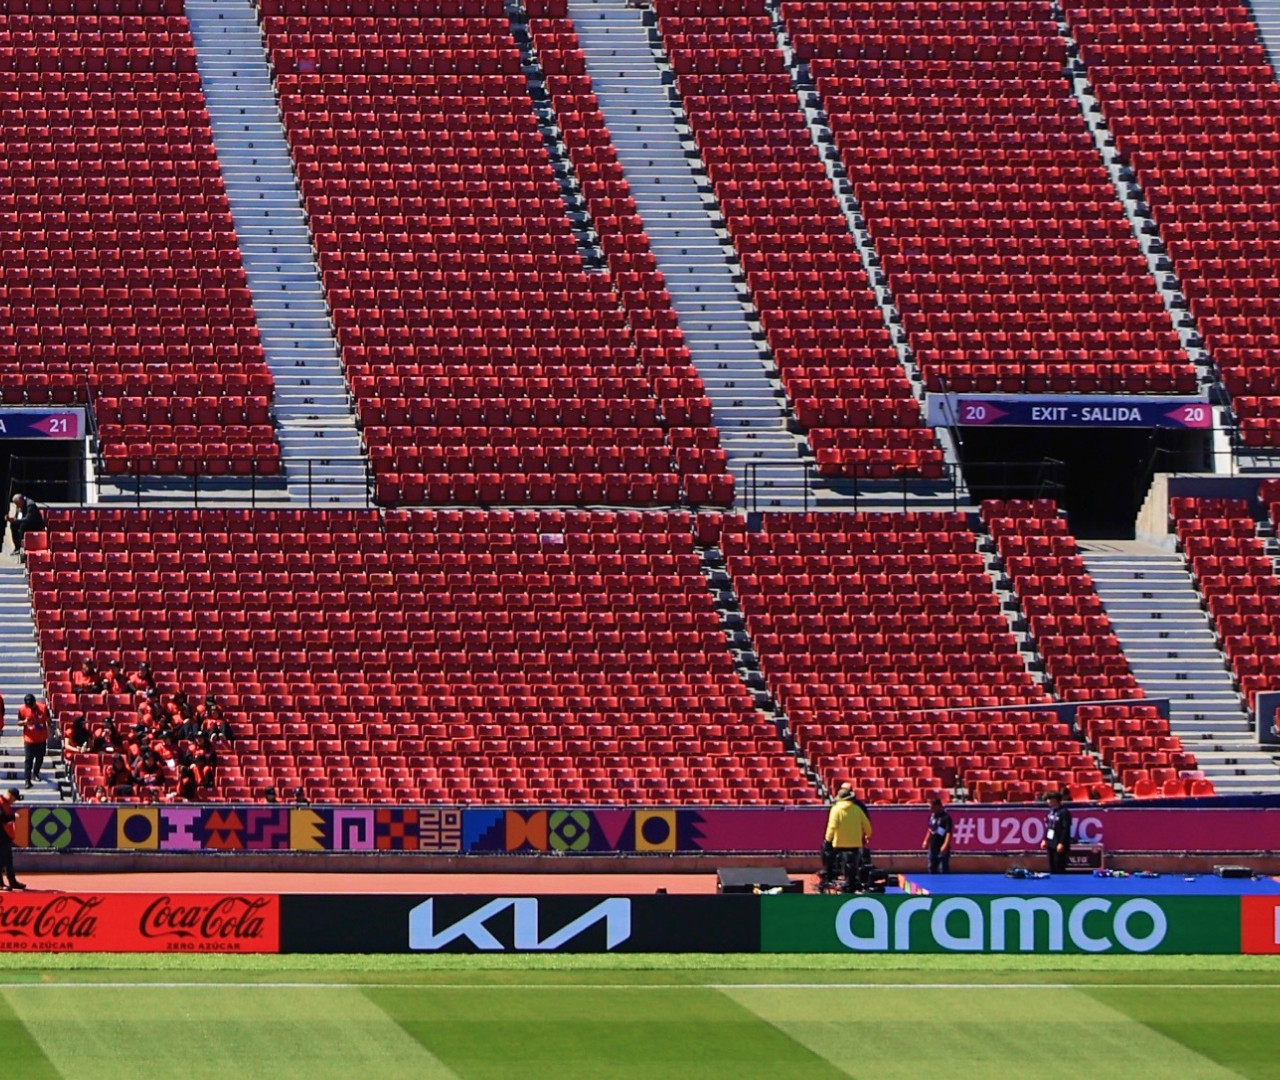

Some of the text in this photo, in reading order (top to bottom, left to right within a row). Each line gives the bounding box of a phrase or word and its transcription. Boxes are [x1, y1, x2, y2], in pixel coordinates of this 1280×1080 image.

[302, 397, 315, 405] AC
[966, 407, 985, 419] 20
[1032, 407, 1068, 420] EXIT
[1082, 408, 1141, 420] SALIDA
[1185, 408, 1204, 421] 20
[50, 419, 66, 432] 21
[954, 817, 1103, 844] #U20C
[139, 897, 269, 938] Coca-Cola
[834, 896, 1168, 952] aramco
[32, 941, 73, 951] AZÚCAR
